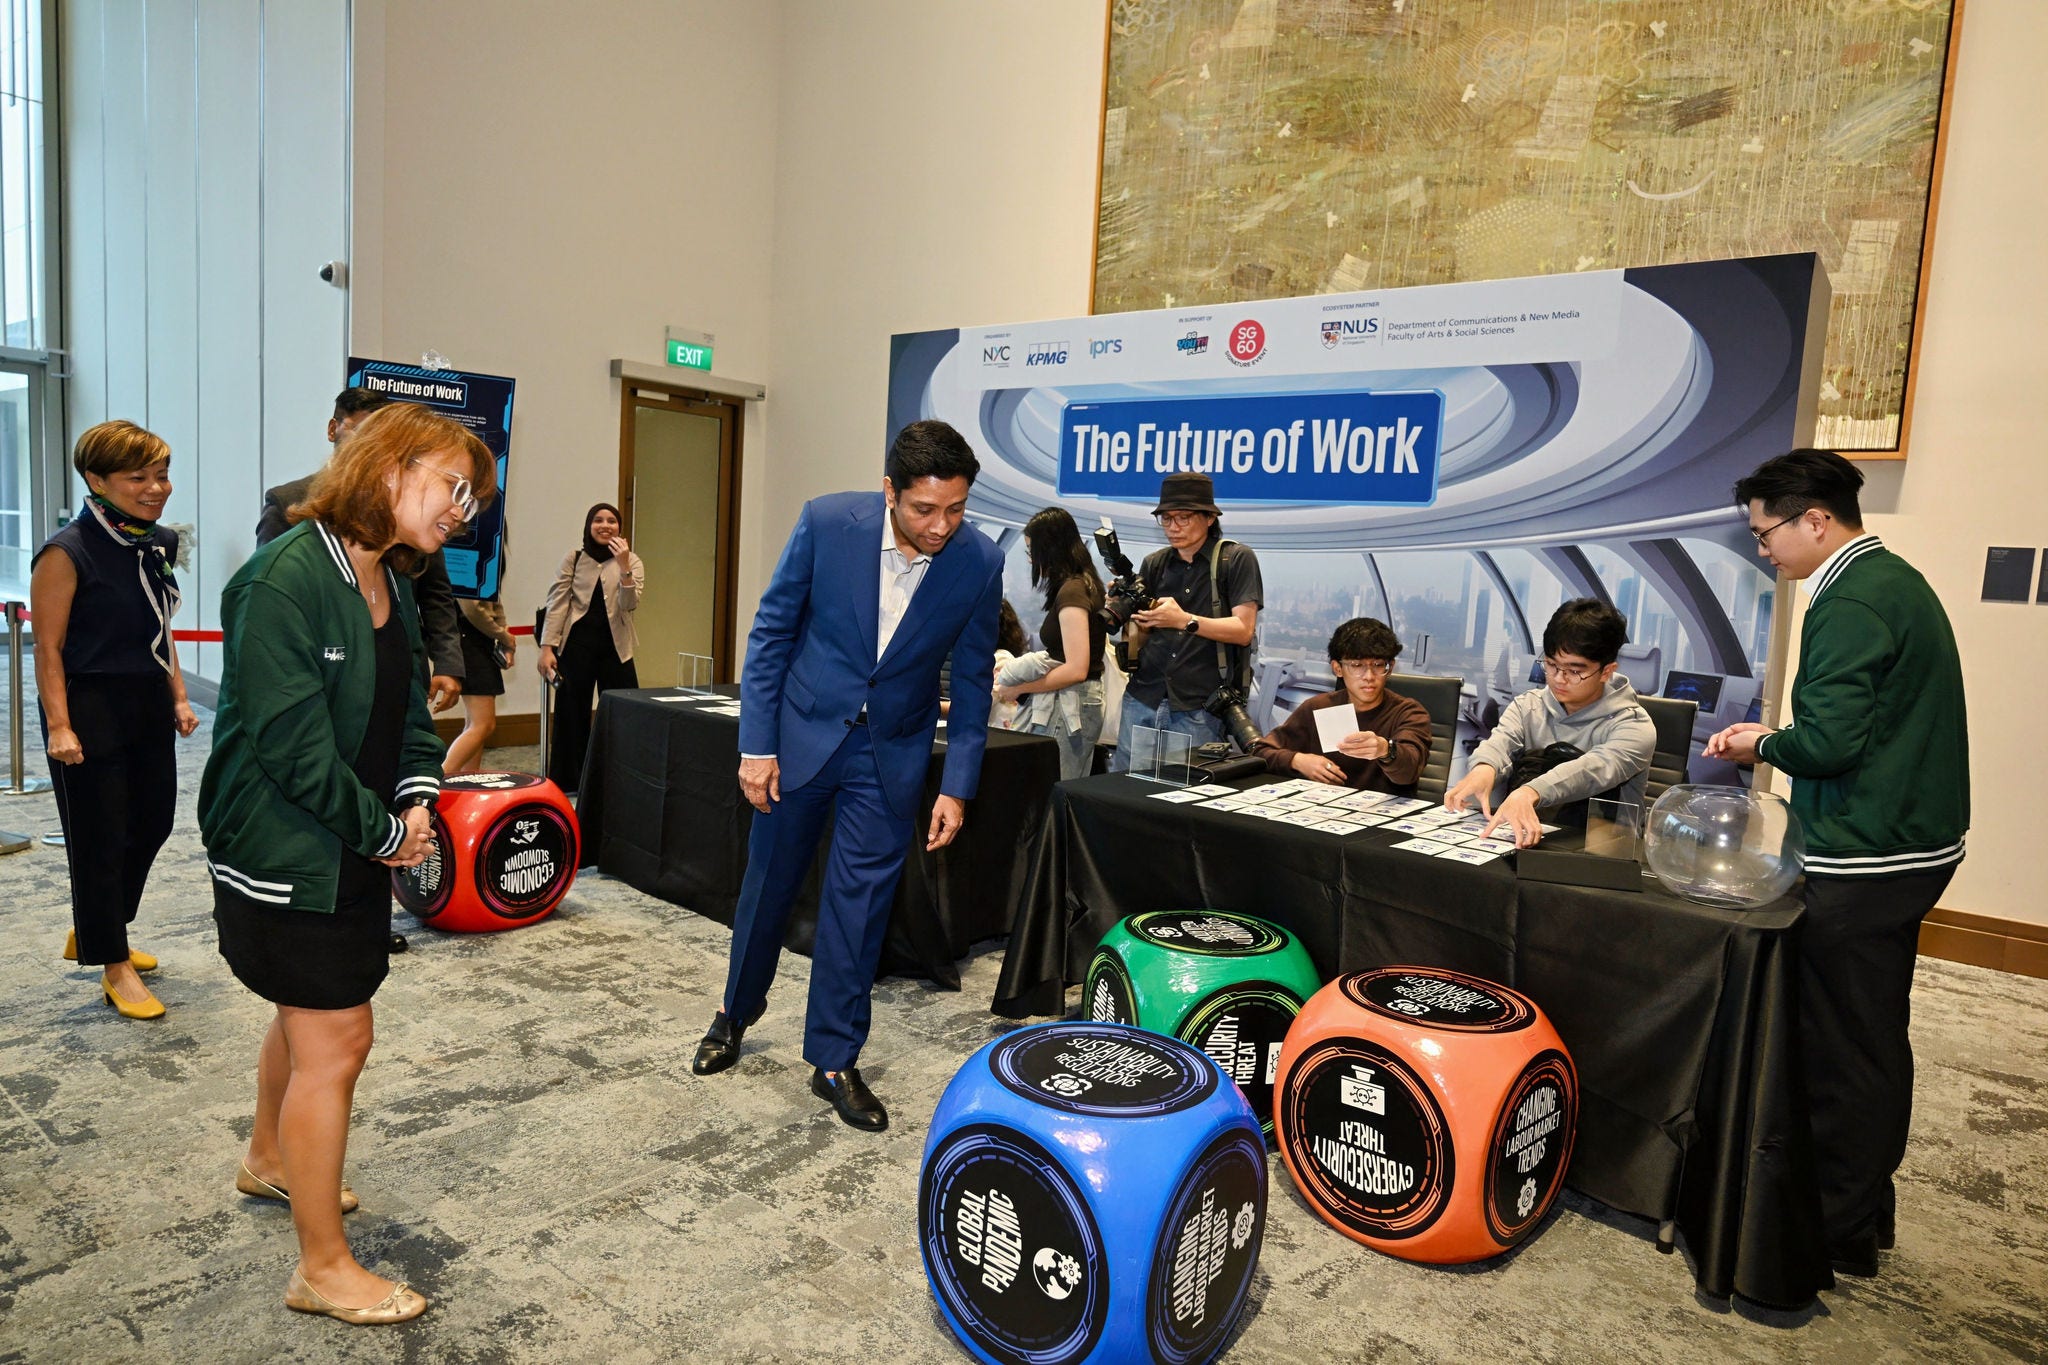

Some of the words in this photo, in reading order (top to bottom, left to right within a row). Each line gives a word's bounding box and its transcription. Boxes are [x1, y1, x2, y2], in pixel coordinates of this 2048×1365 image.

[1322, 303, 1354, 311] ECOSYSTEM
[1355, 301, 1380, 309] PARTNER
[1388, 320, 1436, 330] Department
[1437, 319, 1446, 327] of
[1448, 315, 1518, 327] Communications
[1520, 314, 1527, 322] &
[1529, 312, 1550, 321] New
[1551, 310, 1580, 319] Media
[1238, 326, 1257, 340] SG
[1342, 318, 1378, 334] NUS
[1387, 330, 1414, 341] Faculty
[1416, 329, 1425, 339] of
[1427, 330, 1444, 338] Arts
[1446, 329, 1452, 337] &
[1455, 327, 1478, 337] Social
[1480, 326, 1515, 335] Sciences
[677, 346, 704, 366] EXIT
[983, 345, 1011, 362] NYC
[1026, 350, 1068, 366] KPMG
[1089, 337, 1122, 359] iprs
[1225, 350, 1250, 367] SIGNATURE
[1251, 348, 1268, 365] EVENT
[1236, 340, 1256, 354] 60
[367, 376, 387, 392] The
[387, 378, 422, 396] Future
[423, 383, 436, 398] of
[435, 384, 463, 401] Work
[1073, 424, 1130, 473] The
[1136, 422, 1255, 474] Future
[1261, 420, 1305, 474] of
[1312, 417, 1423, 474] Work
[500, 862, 554, 893] ECONOMIC
[505, 849, 550, 872] SLOWDOWN
[1092, 978, 1109, 1022] NOMIC
[1392, 985, 1471, 1013] REGULATIONS
[1400, 976, 1500, 1009] SUSTAINABILITY
[1066, 1037, 1177, 1079] SUSTAINABILITY
[1204, 1014, 1239, 1077] ECURITY
[1054, 1052, 1142, 1087] REGULATIONS
[1235, 1041, 1257, 1085] THREAT
[1516, 1086, 1557, 1132] CHANGING
[1338, 1121, 1386, 1155] THREAT
[1505, 1125, 1535, 1158] LABOUR
[1534, 1109, 1561, 1142] MARKET
[1313, 1135, 1414, 1195] CYBERSECURITY
[1517, 1137, 1547, 1174] TRENDS
[956, 1189, 986, 1266] GLOBAL
[1198, 1187, 1216, 1260] MARKET
[981, 1188, 1023, 1294] PANDEMIC
[1208, 1207, 1229, 1285] TRENDS
[1172, 1212, 1201, 1322] CHANGING
[1192, 1254, 1210, 1329] LABOUR
